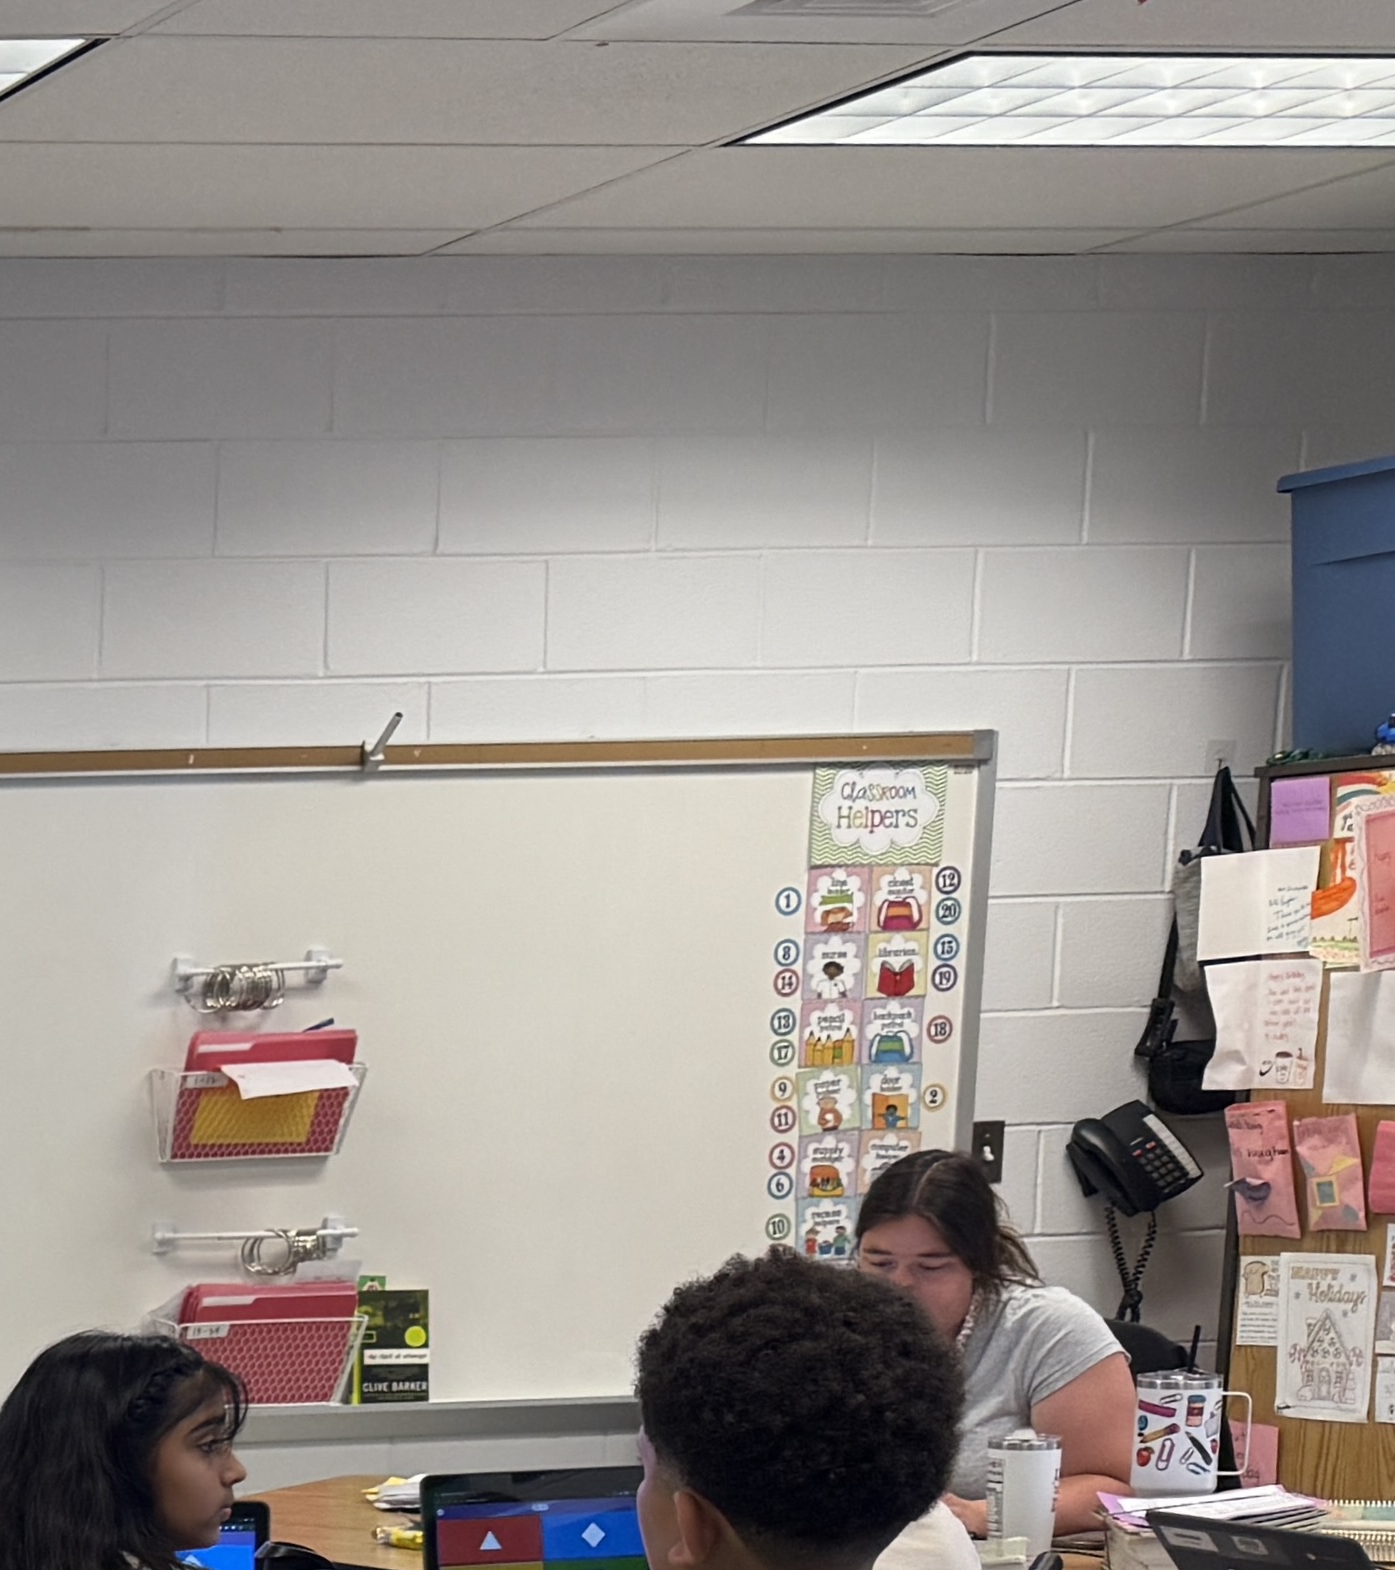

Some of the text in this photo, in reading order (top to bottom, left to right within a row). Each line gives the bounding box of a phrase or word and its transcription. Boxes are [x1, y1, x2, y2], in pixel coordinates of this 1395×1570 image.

[836, 805, 918, 834] Helpers
[941, 873, 956, 888] 12
[784, 893, 792, 909] 1
[940, 904, 956, 919] 20
[782, 947, 791, 961] 8
[939, 942, 954, 956] 15
[780, 975, 793, 990] 14
[938, 971, 951, 986] 19
[776, 1014, 791, 1030] 13
[933, 1022, 947, 1037] 18
[775, 1046, 790, 1061] 17
[779, 1082, 787, 1097] 9
[929, 1090, 938, 1104] 2
[776, 1112, 790, 1127] 11
[777, 1149, 786, 1162] 4
[775, 1178, 784, 1193] 6
[770, 1219, 785, 1235] 10
[363, 1381, 428, 1393] CLIVE BARKER
